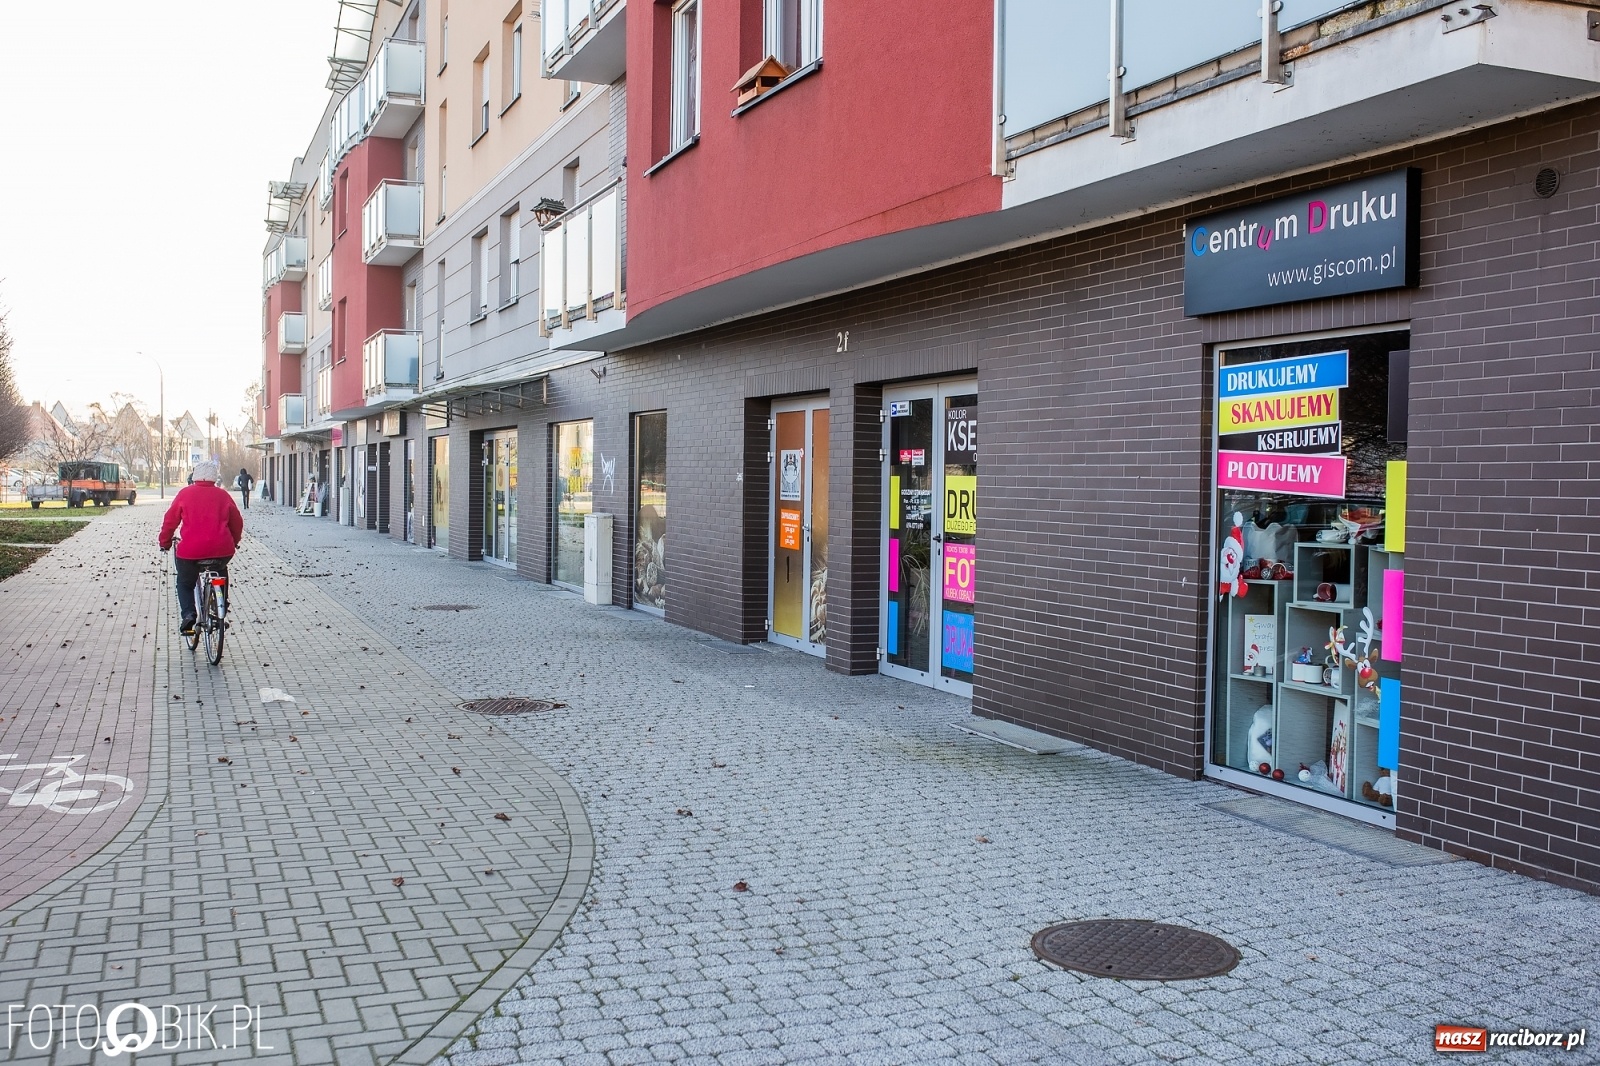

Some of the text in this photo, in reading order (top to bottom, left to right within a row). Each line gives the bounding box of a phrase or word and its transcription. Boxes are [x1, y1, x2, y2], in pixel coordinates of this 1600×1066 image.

[1191, 190, 1397, 257] Centrum Druku
[1267, 245, 1396, 287] www.giscom.pl
[836, 330, 850, 353] 2f
[1227, 362, 1319, 392] DRUKUJEMY
[947, 409, 967, 420] KOLOR
[1231, 392, 1334, 425] SKANUJEMY
[947, 419, 977, 452] KSE
[1257, 425, 1339, 451] KSERUJEMY
[1227, 460, 1323, 484] PLOTUJEMY
